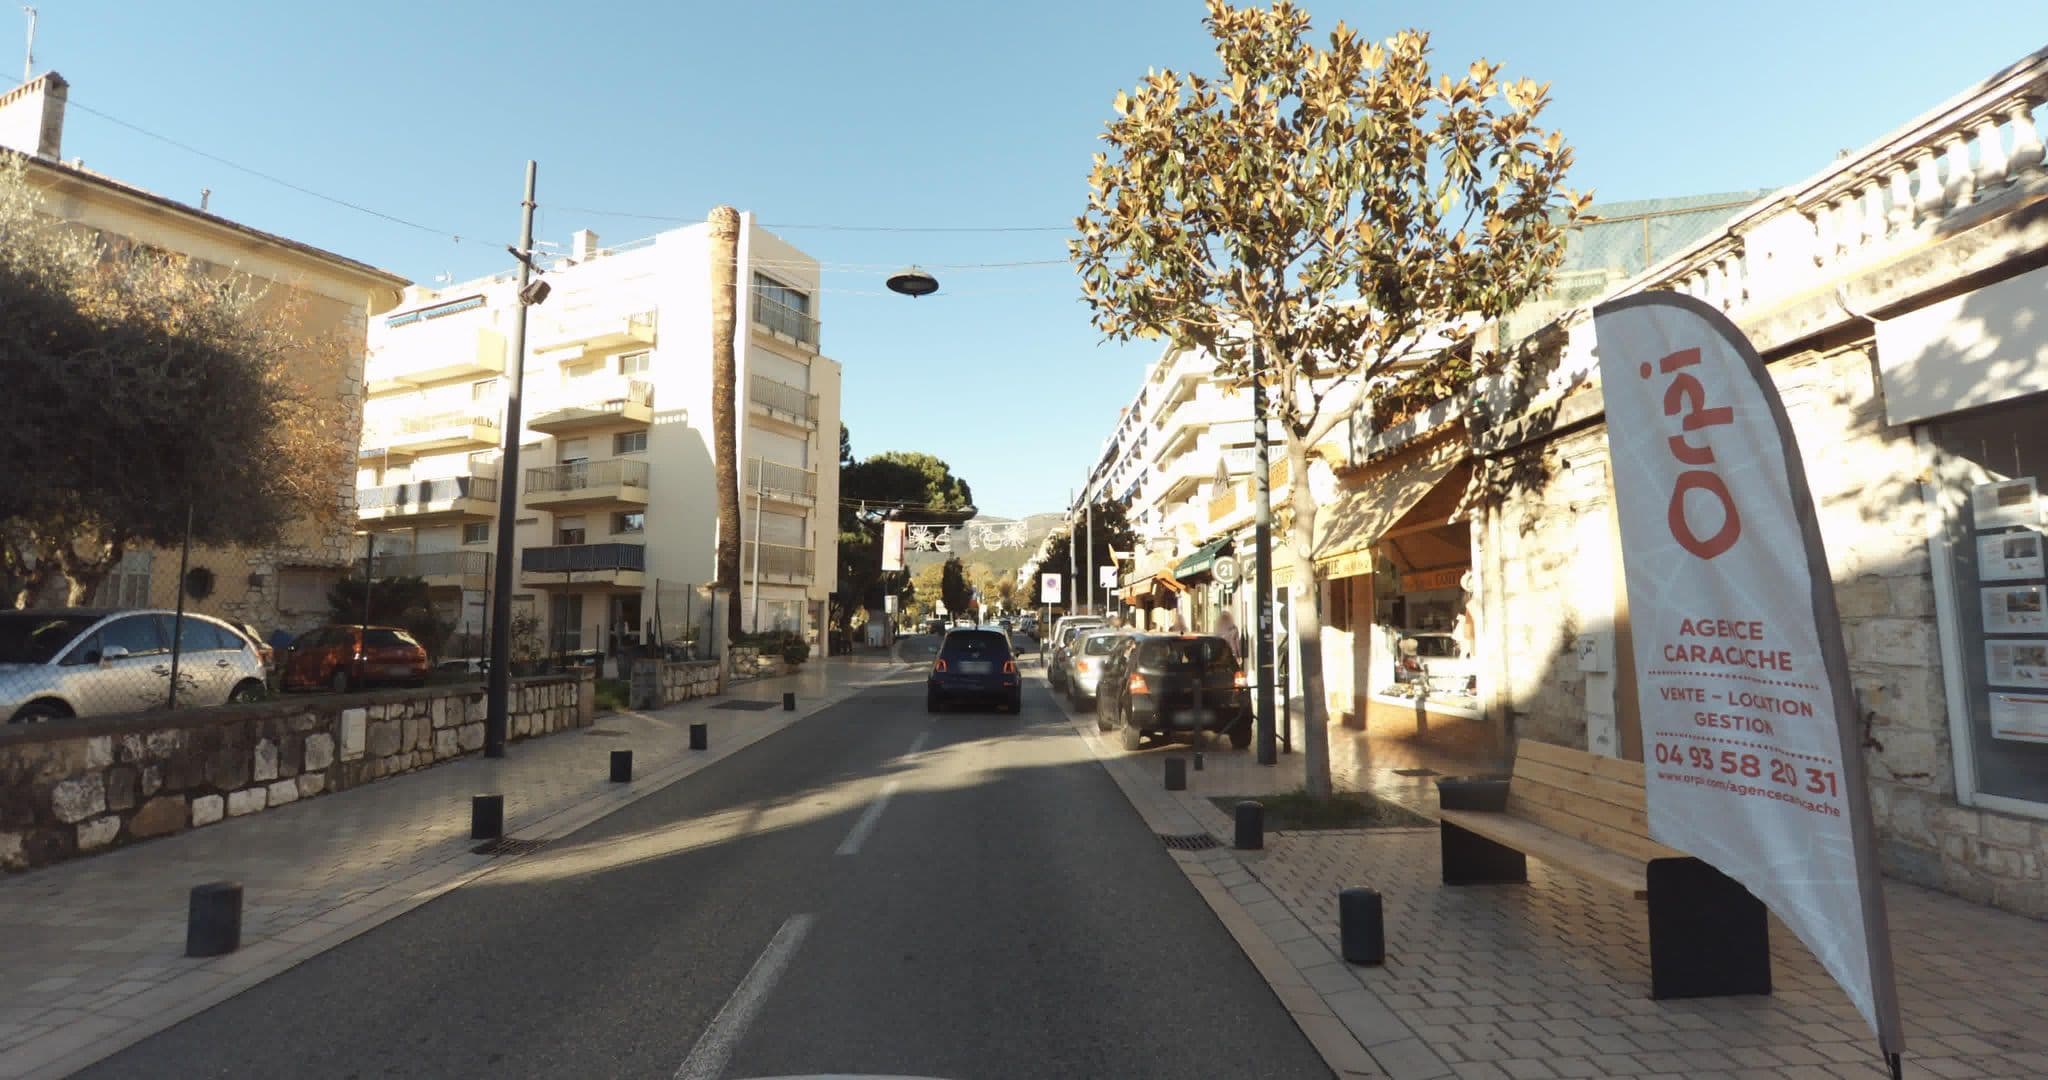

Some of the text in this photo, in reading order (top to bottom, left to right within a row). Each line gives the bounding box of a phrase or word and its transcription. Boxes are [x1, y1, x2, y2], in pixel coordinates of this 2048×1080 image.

[1680, 619, 1763, 640] AGENCE
[1664, 645, 1792, 671] CARACACHE
[1660, 687, 1705, 702] VENTE
[1728, 691, 1813, 717] LOCATION
[1694, 712, 1774, 735] GESTION
[1655, 743, 1837, 797] 04 93 58 20 31
